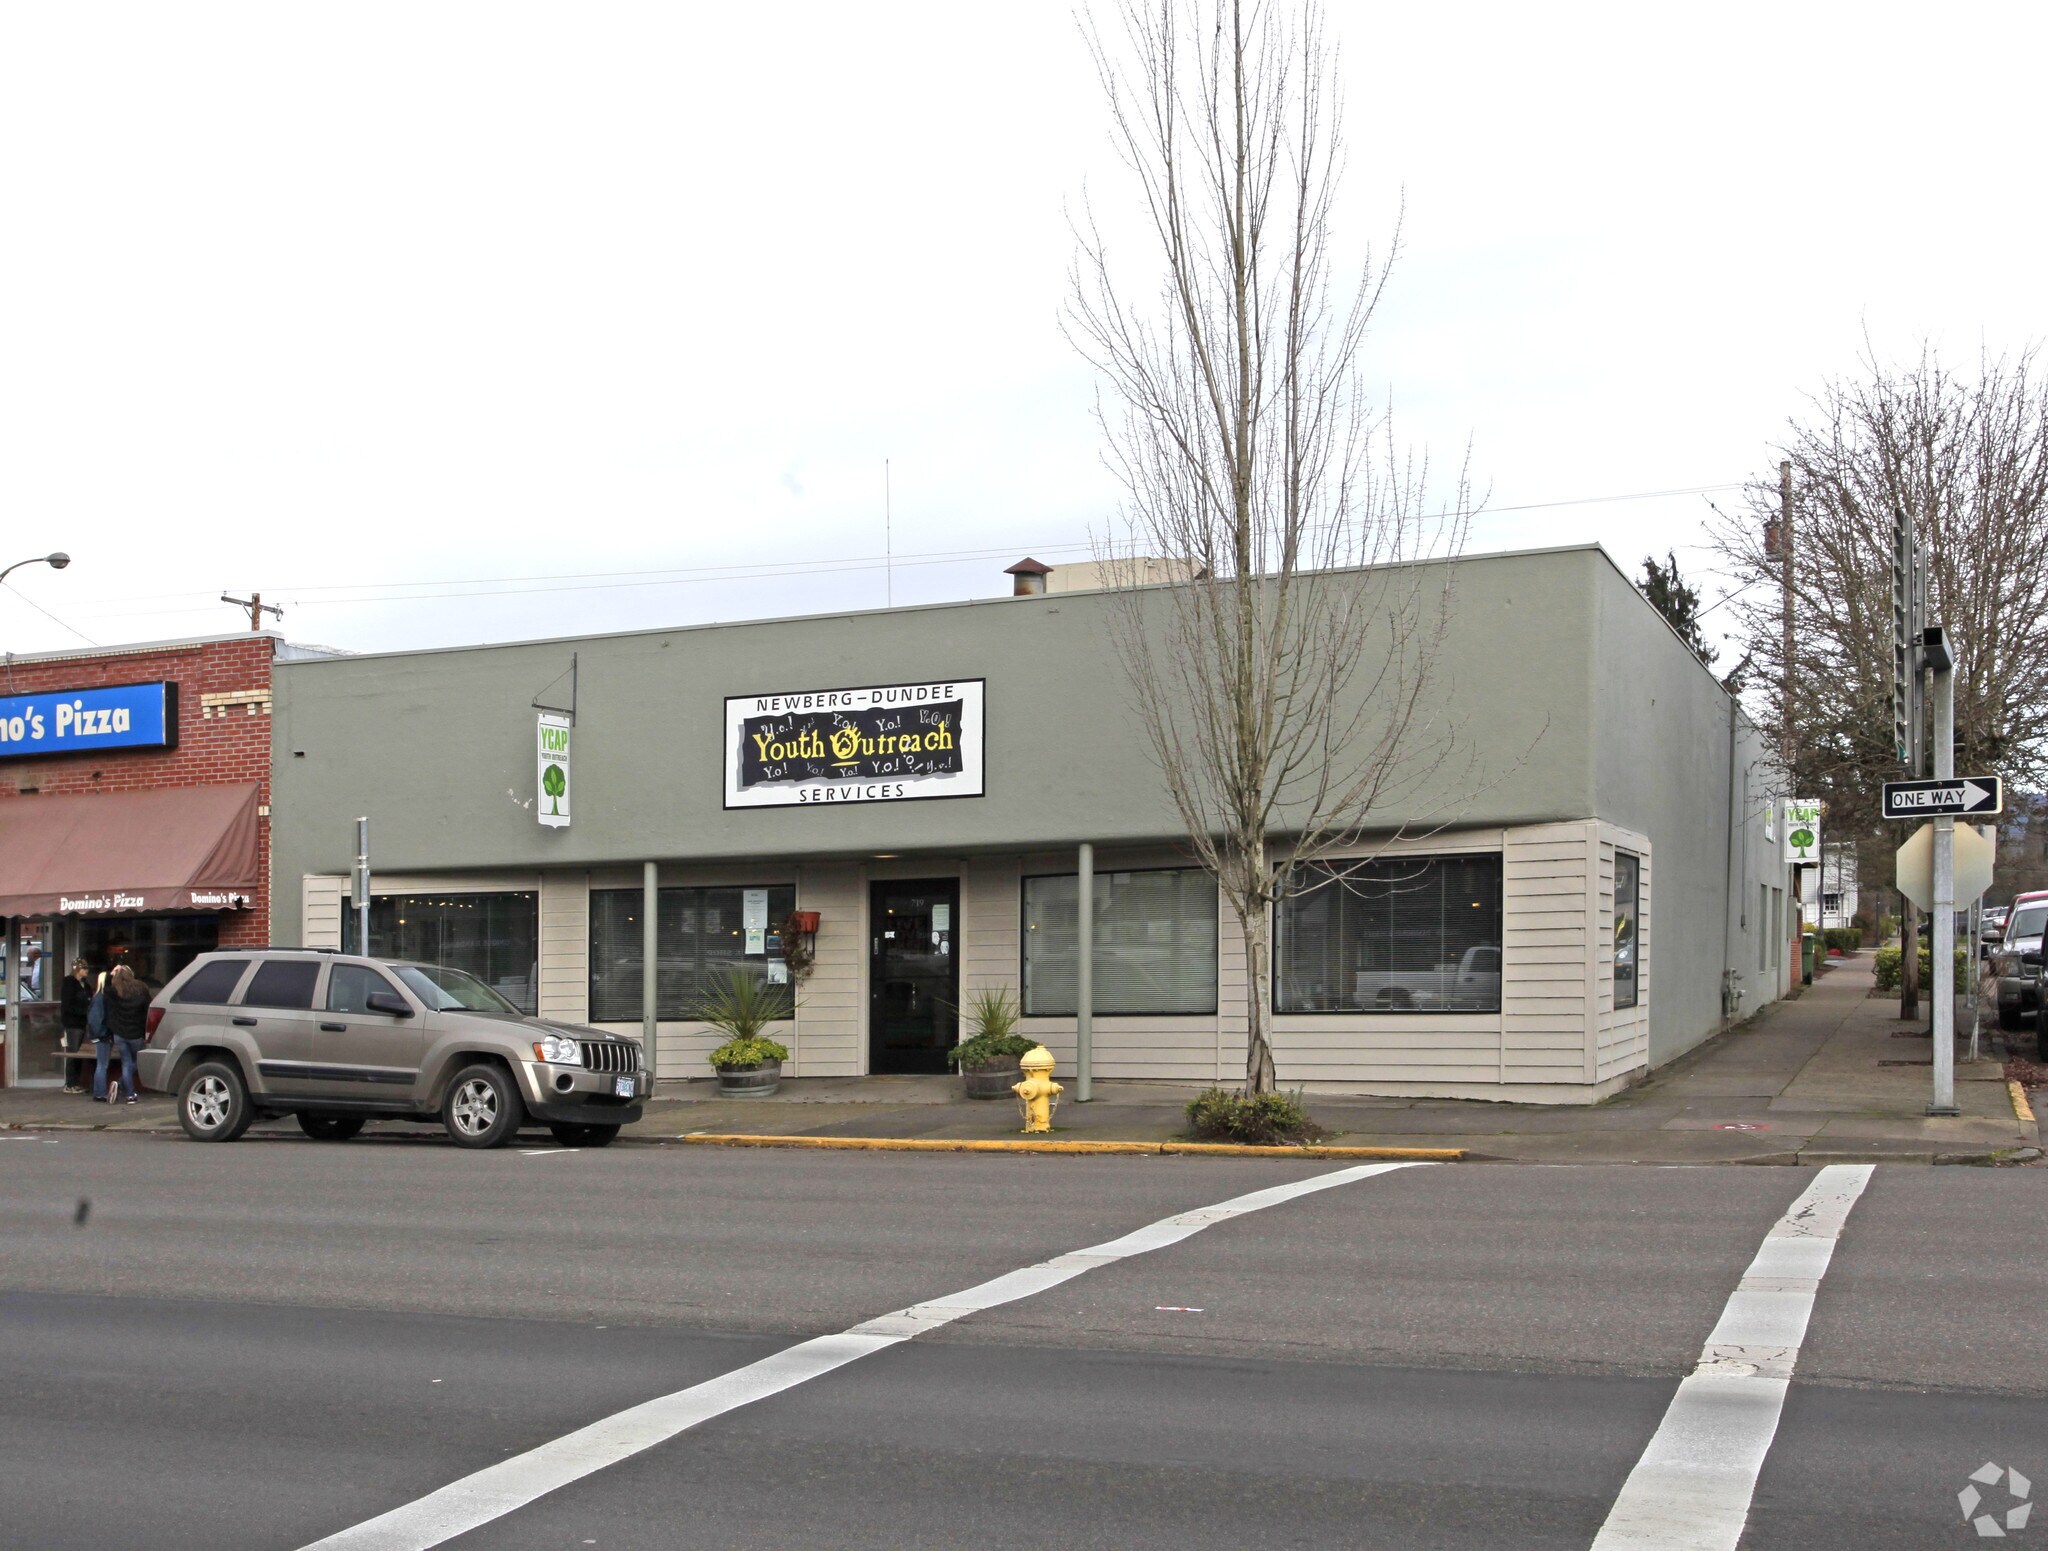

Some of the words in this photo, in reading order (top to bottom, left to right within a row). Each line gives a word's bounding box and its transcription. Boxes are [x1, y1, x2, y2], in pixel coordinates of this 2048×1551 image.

[56, 699, 130, 737] Pizza
[541, 728, 567, 751] YCAP
[752, 729, 826, 762] Youth
[829, 720, 953, 760] Outreach
[799, 784, 904, 803] SERVICES
[1893, 793, 1925, 807] ONE
[1931, 790, 1966, 805] WAY
[60, 894, 111, 911] Domino's
[113, 892, 144, 908] Pizza
[191, 891, 227, 904] Domino's
